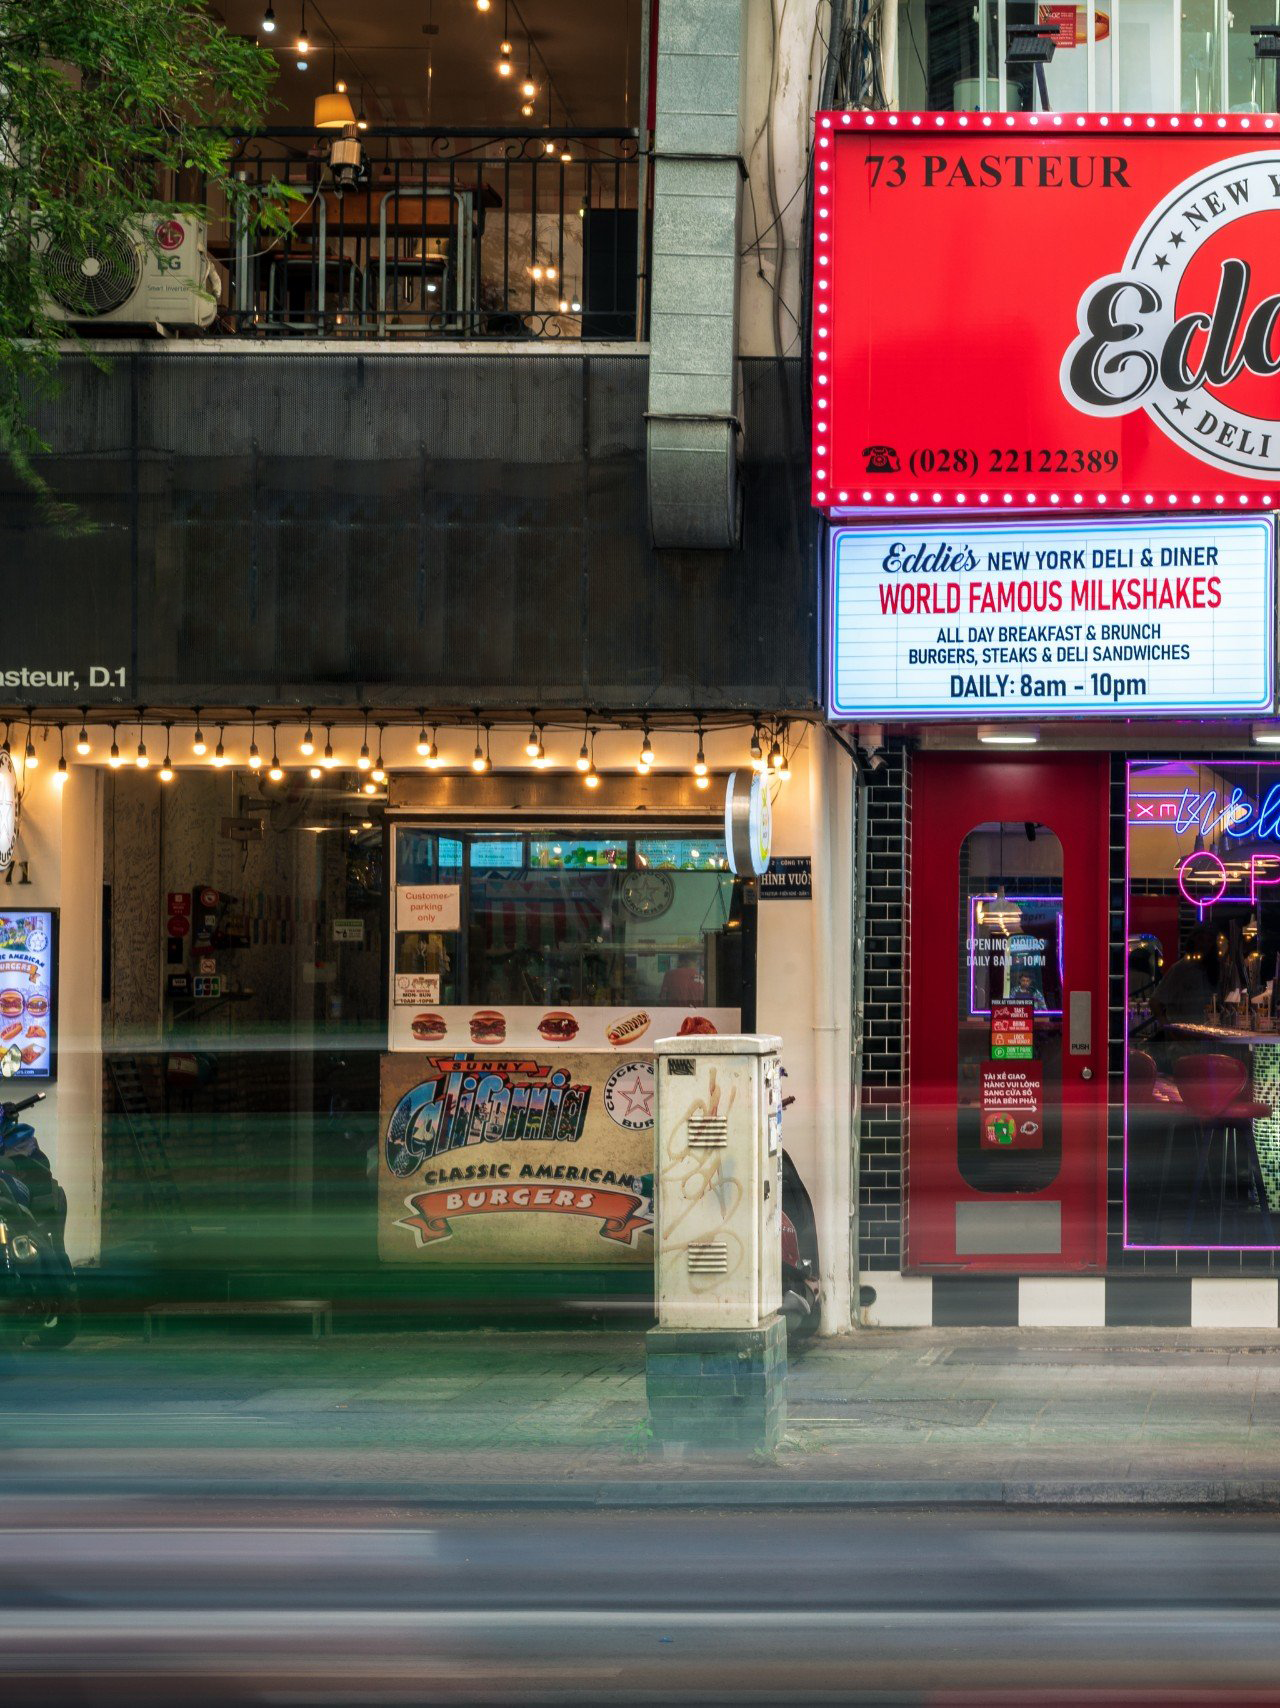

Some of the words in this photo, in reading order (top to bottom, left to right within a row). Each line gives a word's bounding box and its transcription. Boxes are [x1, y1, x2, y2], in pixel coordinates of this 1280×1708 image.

[864, 155, 907, 188] 73
[921, 155, 1132, 188] PASTEUR
[1182, 178, 1250, 232] NEW
[1194, 409, 1272, 458] DELI
[909, 448, 979, 478] (028)
[988, 448, 1119, 474] 22122389
[882, 542, 981, 573] Eddie's
[987, 550, 1032, 571] NEW
[1035, 549, 1085, 570] YORK
[1092, 548, 1134, 568] DELI
[1140, 548, 1153, 567] &
[1161, 546, 1219, 567] DINER
[878, 582, 962, 615] WORLD
[968, 580, 1063, 613] FAMOUS
[1070, 576, 1222, 611] MILKSHAKES
[936, 627, 964, 644] ALL
[968, 626, 995, 643] DAY
[998, 625, 1084, 642] BREAKFAST
[1086, 625, 1097, 641] &
[1101, 624, 1162, 641] BRUNCH
[908, 648, 979, 667] BURGERS,
[982, 646, 1038, 664] STEAKS
[1041, 647, 1053, 663] &
[1056, 646, 1089, 662] DELI
[1092, 644, 1190, 662] SANDWICHES
[89, 666, 126, 688] D.1
[950, 675, 1015, 698] DAILY:
[1020, 674, 1067, 697] 8am
[1090, 673, 1147, 702] 10pm
[761, 870, 786, 885] HÌNH
[406, 892, 448, 900] Customer
[410, 903, 443, 912] parking
[417, 914, 436, 922] only
[966, 939, 1008, 951] OPENING
[1013, 939, 1045, 951] HOURS
[966, 956, 990, 966] DAILY
[993, 956, 1012, 966] 8AM
[1022, 956, 1046, 966] 10PM
[451, 1062, 525, 1072] SUNNY
[424, 1163, 512, 1186] CLASSIC
[519, 1163, 635, 1190] AMERICAN
[446, 1188, 596, 1211] BURGERS
